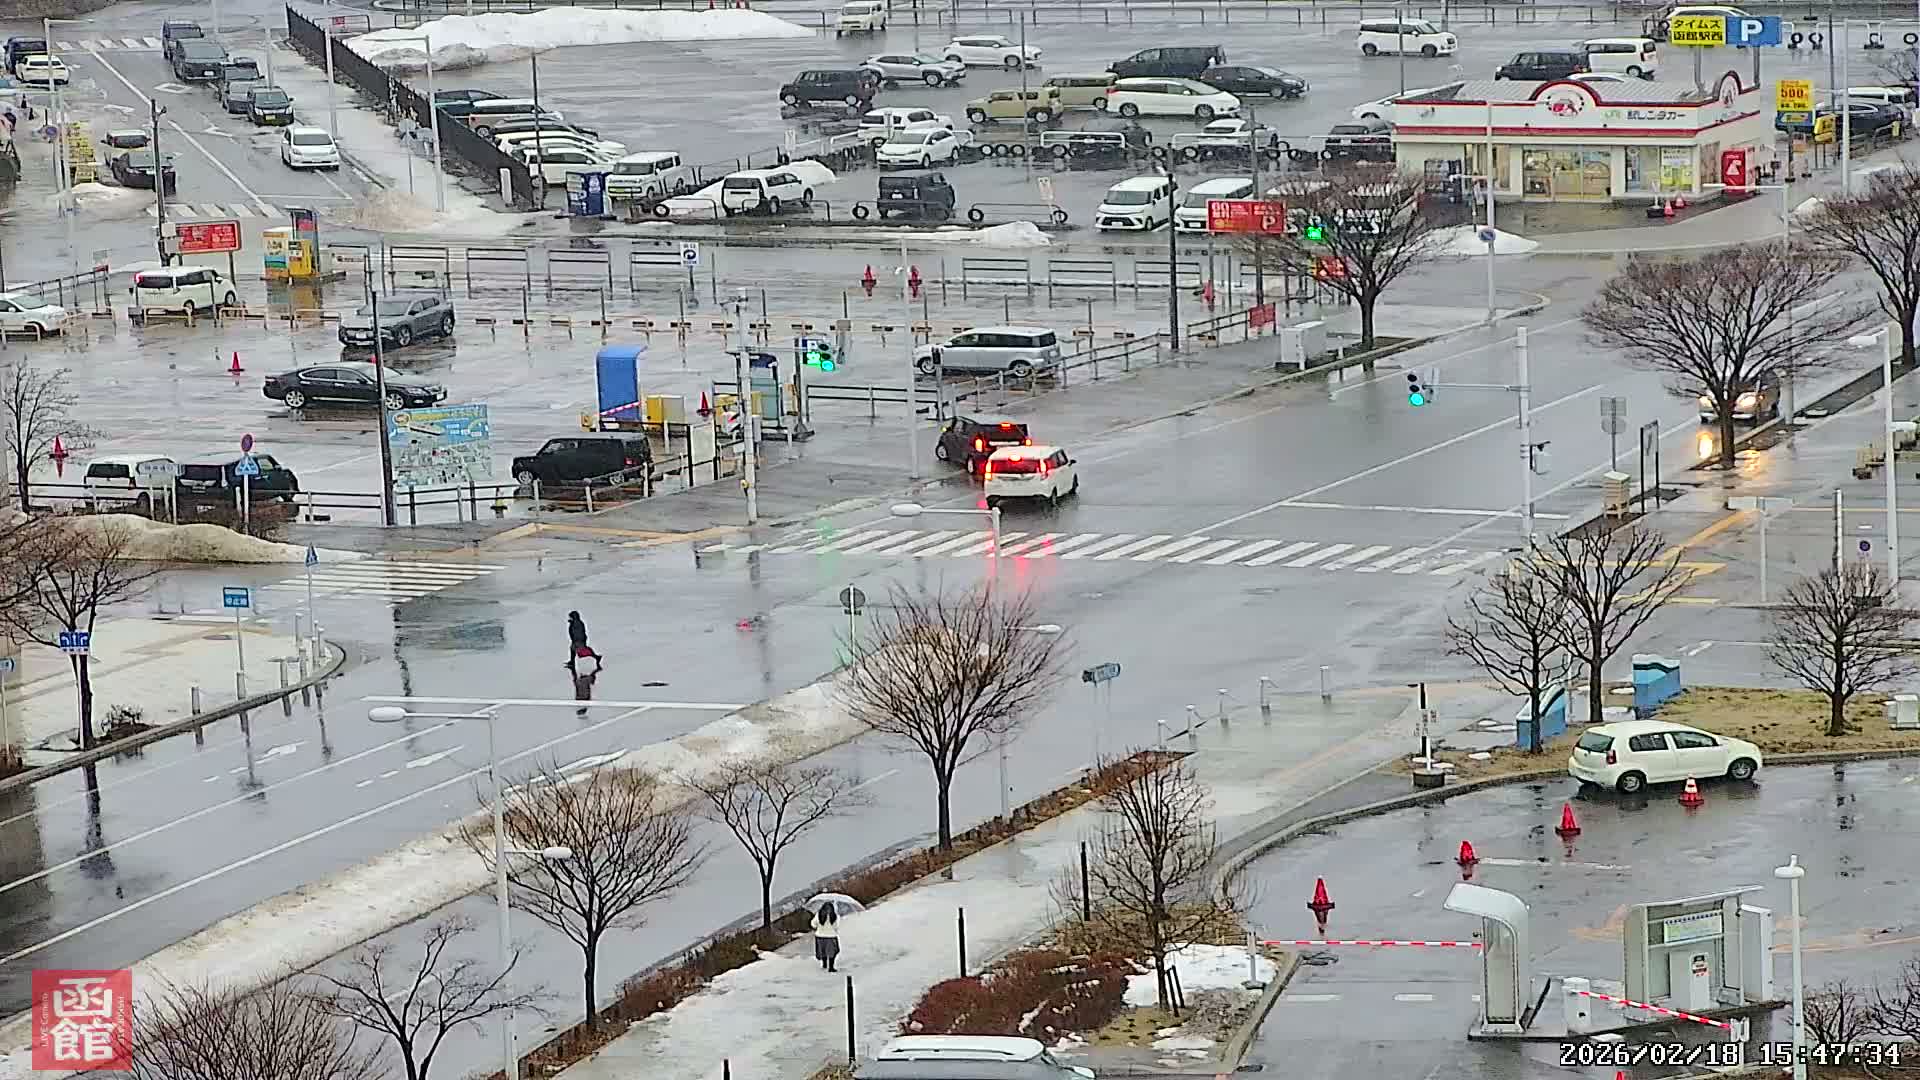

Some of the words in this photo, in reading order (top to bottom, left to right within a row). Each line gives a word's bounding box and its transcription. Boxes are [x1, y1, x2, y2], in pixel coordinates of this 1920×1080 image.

[1741, 20, 1764, 41] P
[1627, 110, 1686, 120] 駅レンタカー
